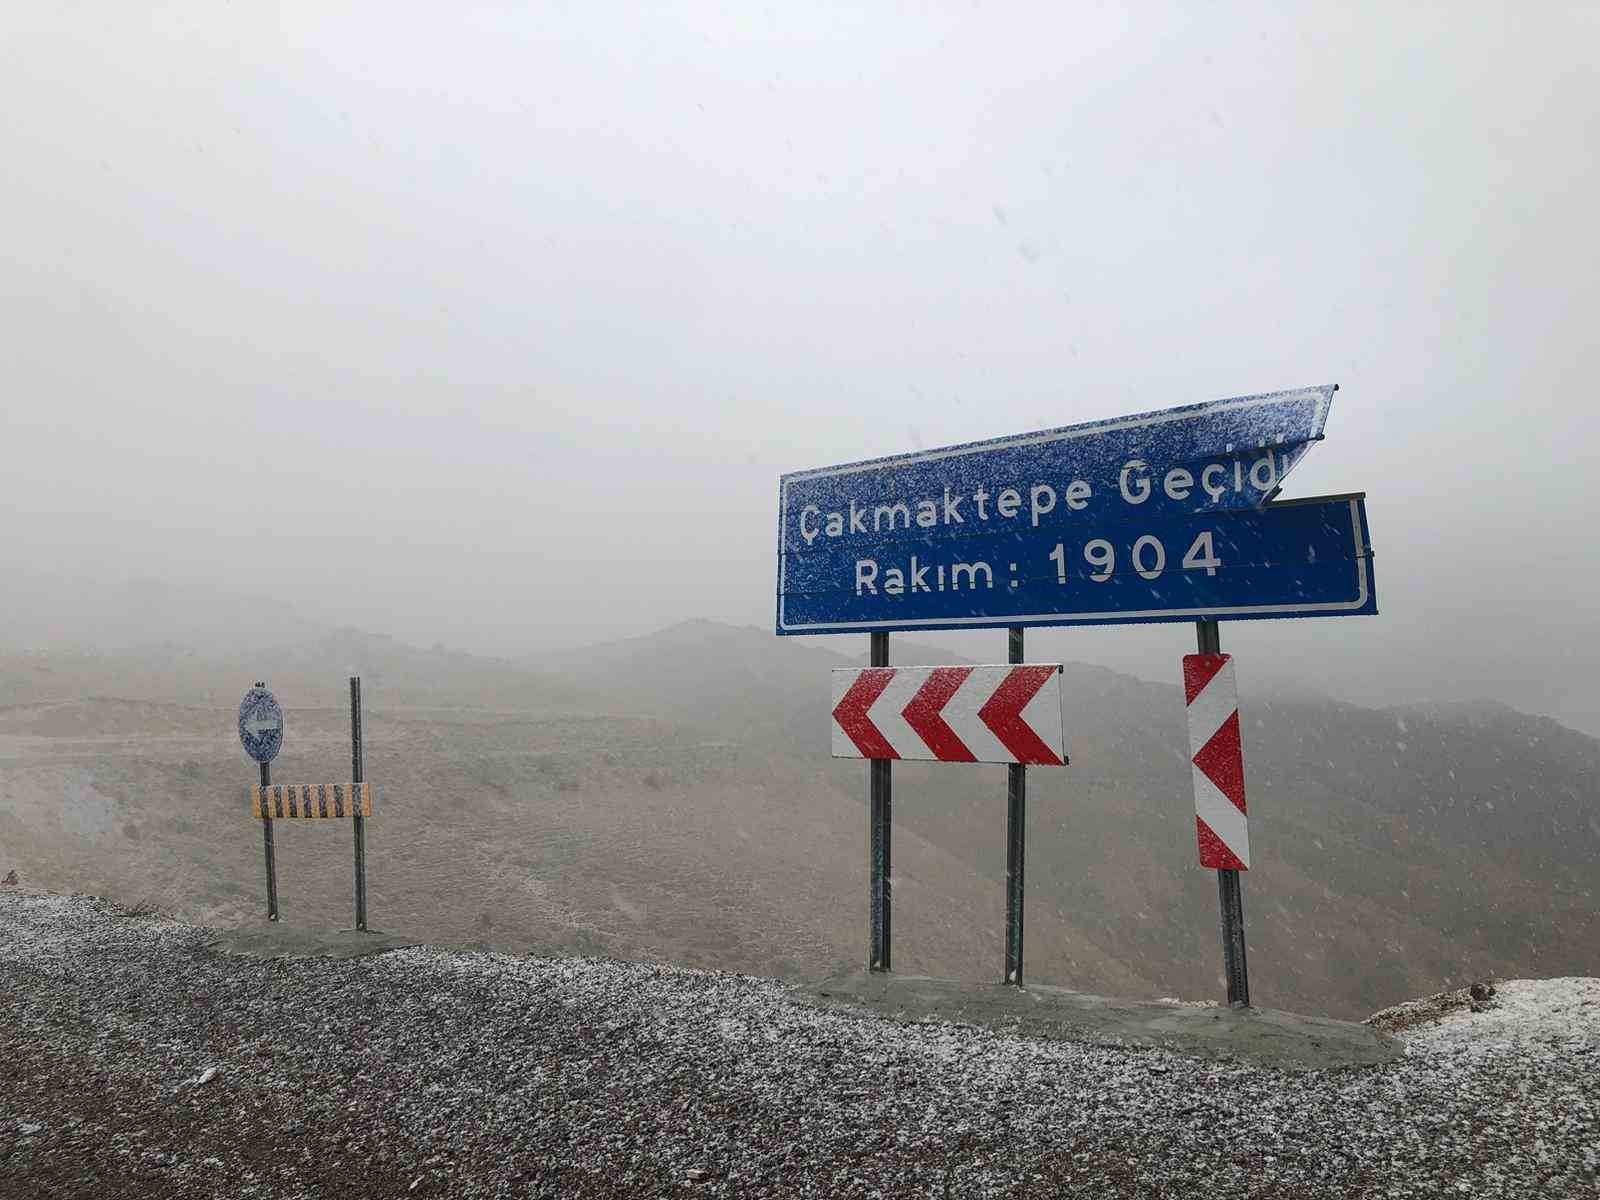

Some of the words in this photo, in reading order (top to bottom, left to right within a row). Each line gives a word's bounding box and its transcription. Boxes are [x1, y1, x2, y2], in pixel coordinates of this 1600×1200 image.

[799, 479, 1092, 544] Çakmaktepe
[855, 556, 993, 597] Rakım
[1049, 531, 1222, 585] 1904
